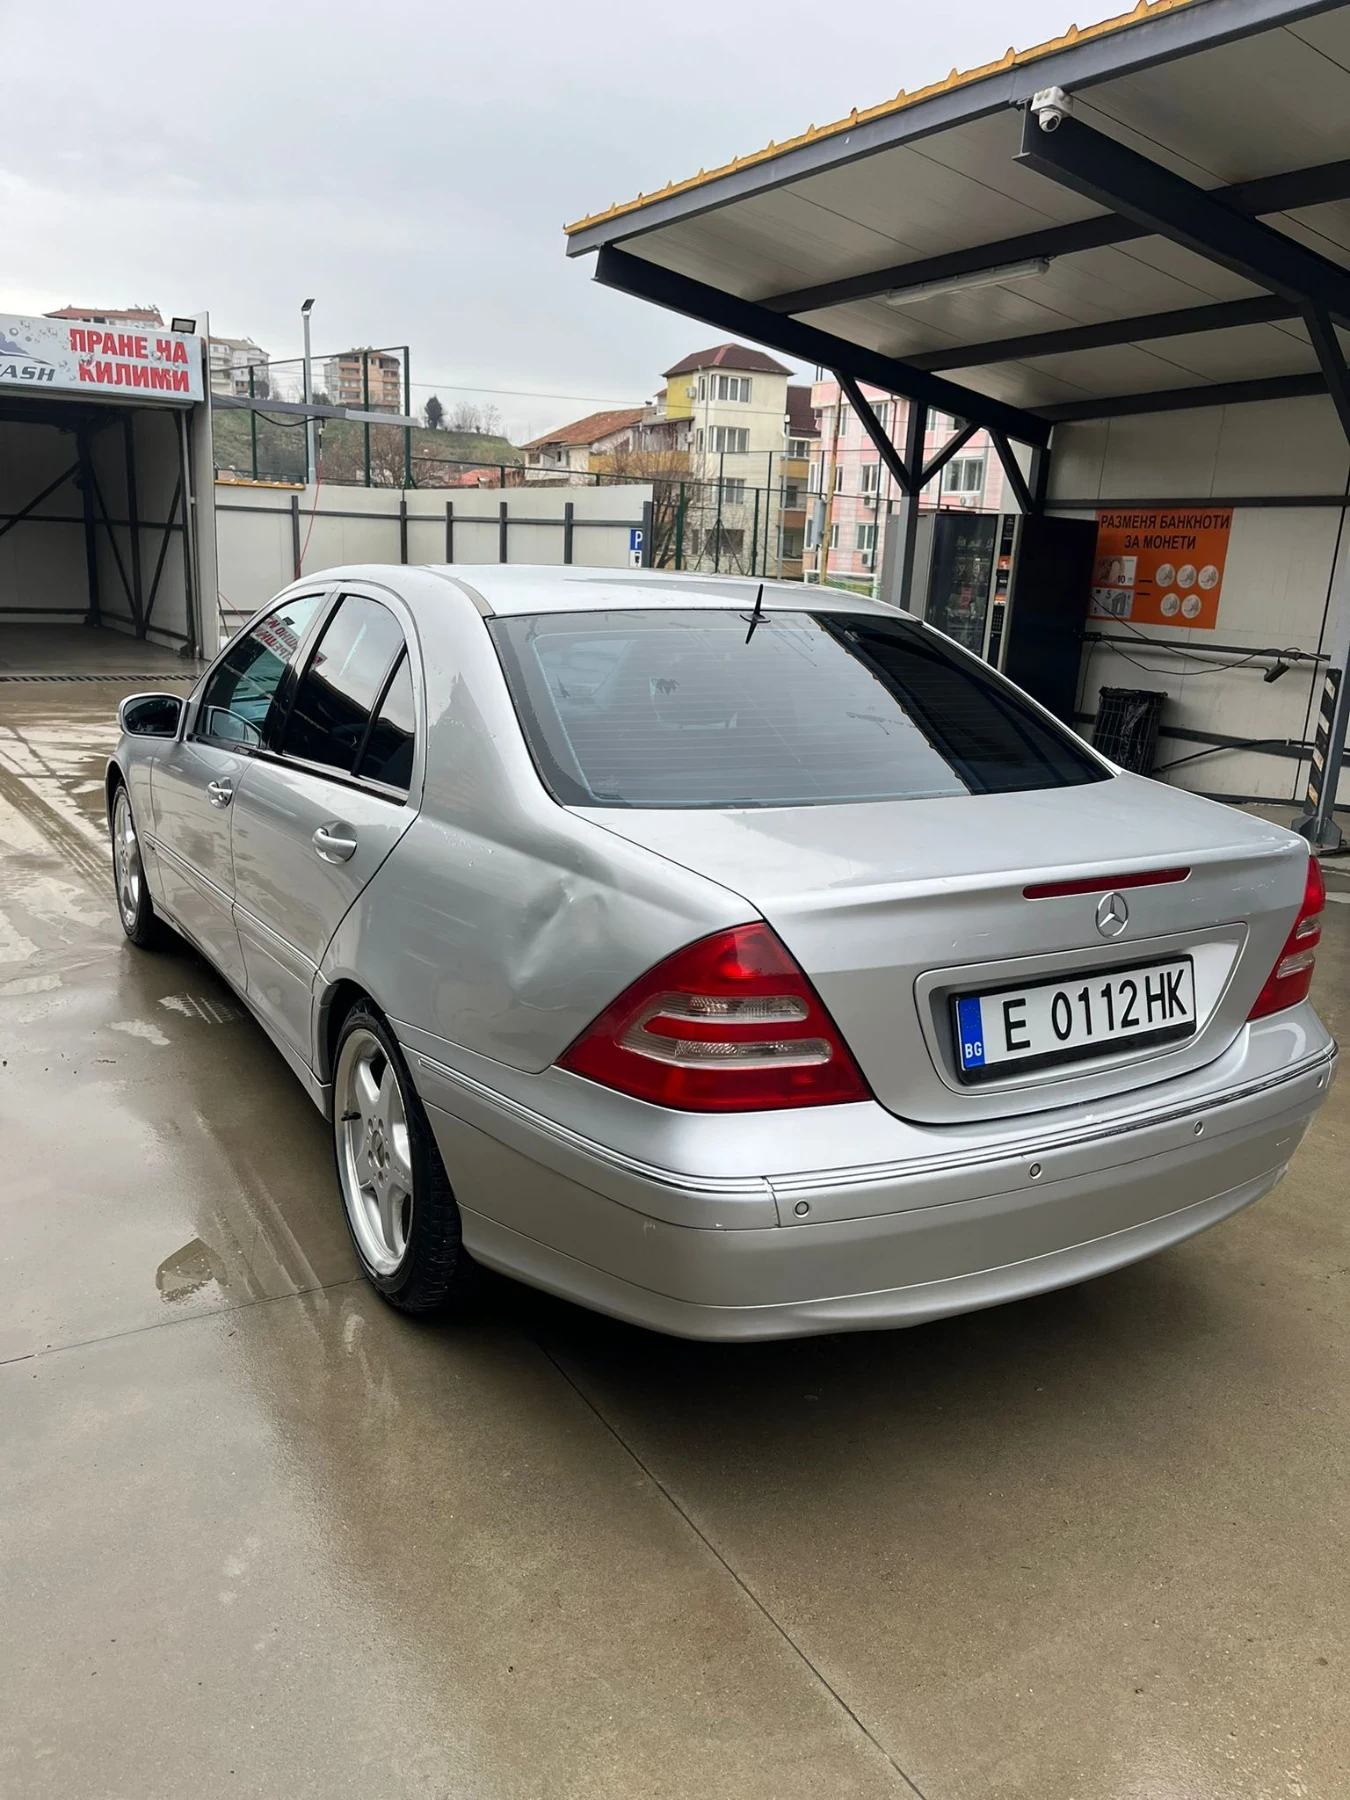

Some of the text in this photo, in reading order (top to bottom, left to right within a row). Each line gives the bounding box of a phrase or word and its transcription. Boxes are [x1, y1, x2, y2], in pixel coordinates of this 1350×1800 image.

[70, 328, 188, 364] ПРАНЕ НА
[0, 364, 56, 382] ASH
[79, 360, 189, 392] КИЛИМИ
[1100, 514, 1230, 530] РАЗМЕНЯ БАНКНОТИ
[634, 530, 643, 549] P
[1124, 535, 1196, 550] ЗА МОНЕТИ
[1117, 575, 1126, 584] 10
[1105, 589, 1112, 599] 5
[1003, 998, 1031, 1052] E
[965, 1041, 982, 1059] BG
